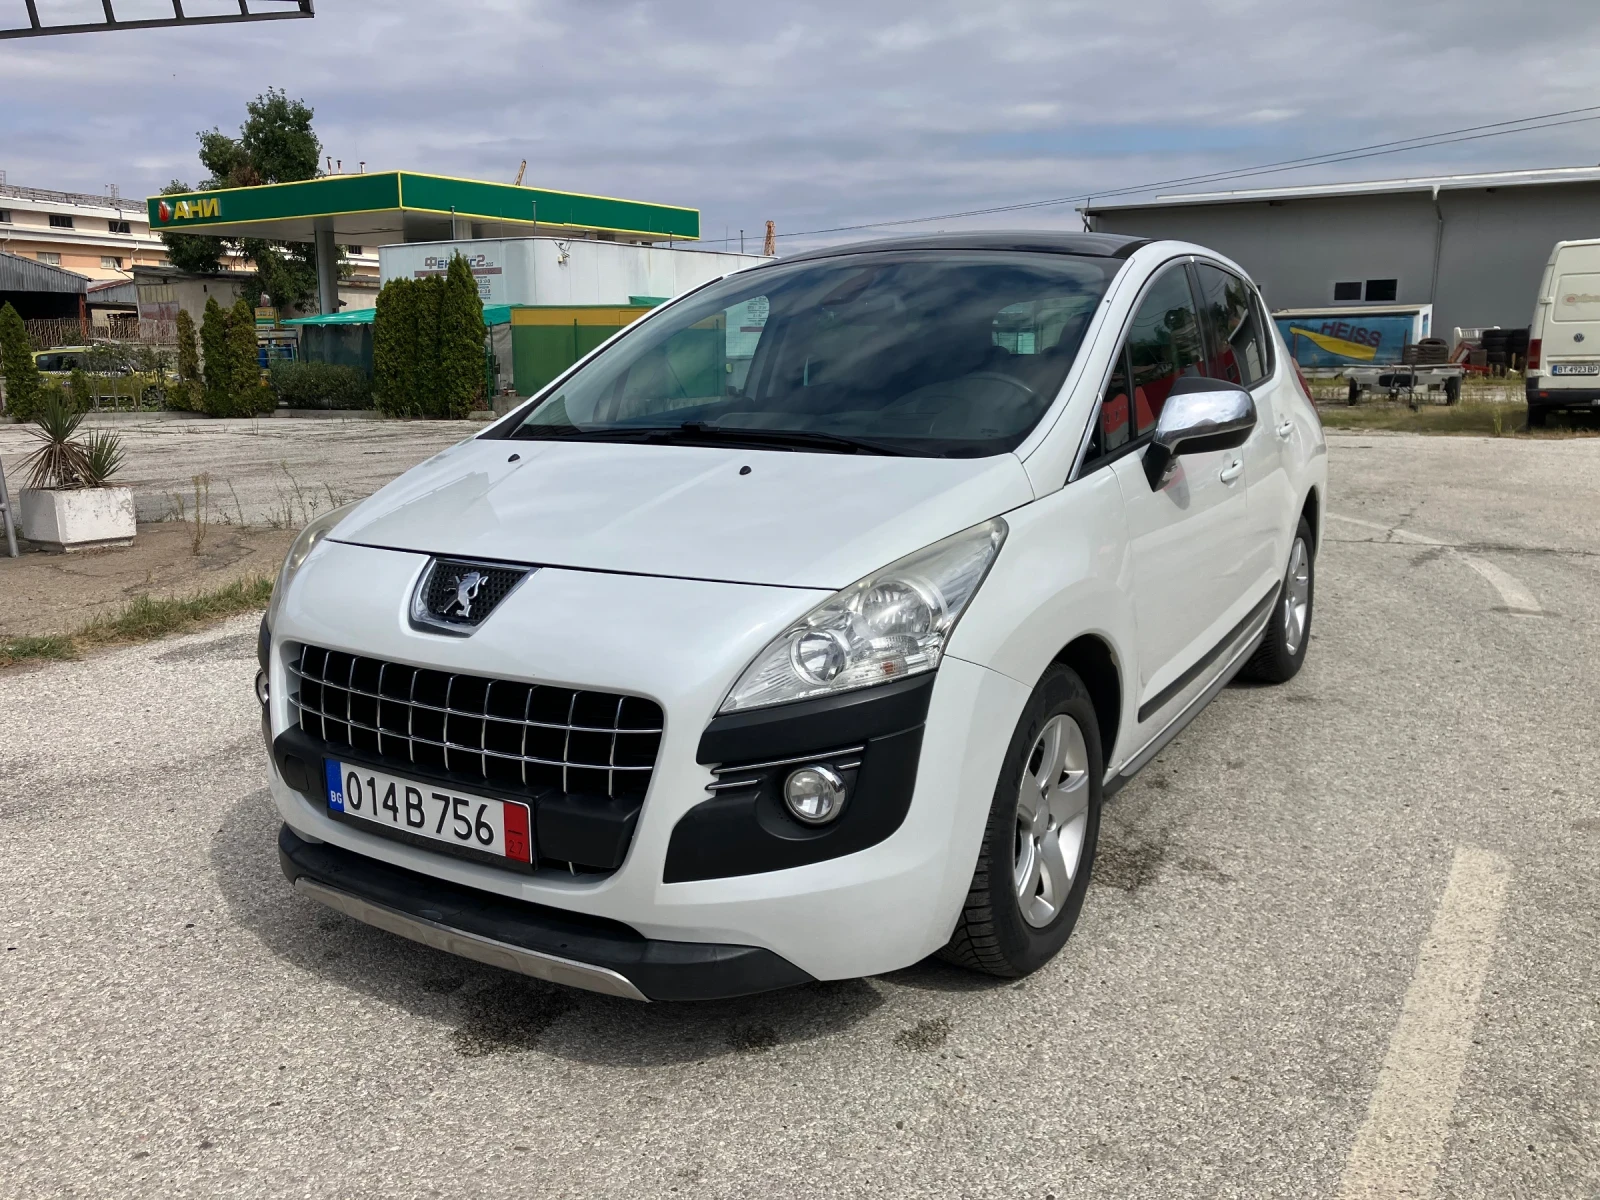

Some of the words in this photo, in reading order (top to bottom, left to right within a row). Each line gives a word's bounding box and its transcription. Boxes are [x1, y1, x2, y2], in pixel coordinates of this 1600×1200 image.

[174, 198, 221, 220] АНИ
[1321, 321, 1382, 348] HEISS
[330, 790, 342, 804] BG
[508, 839, 524, 856] 27
